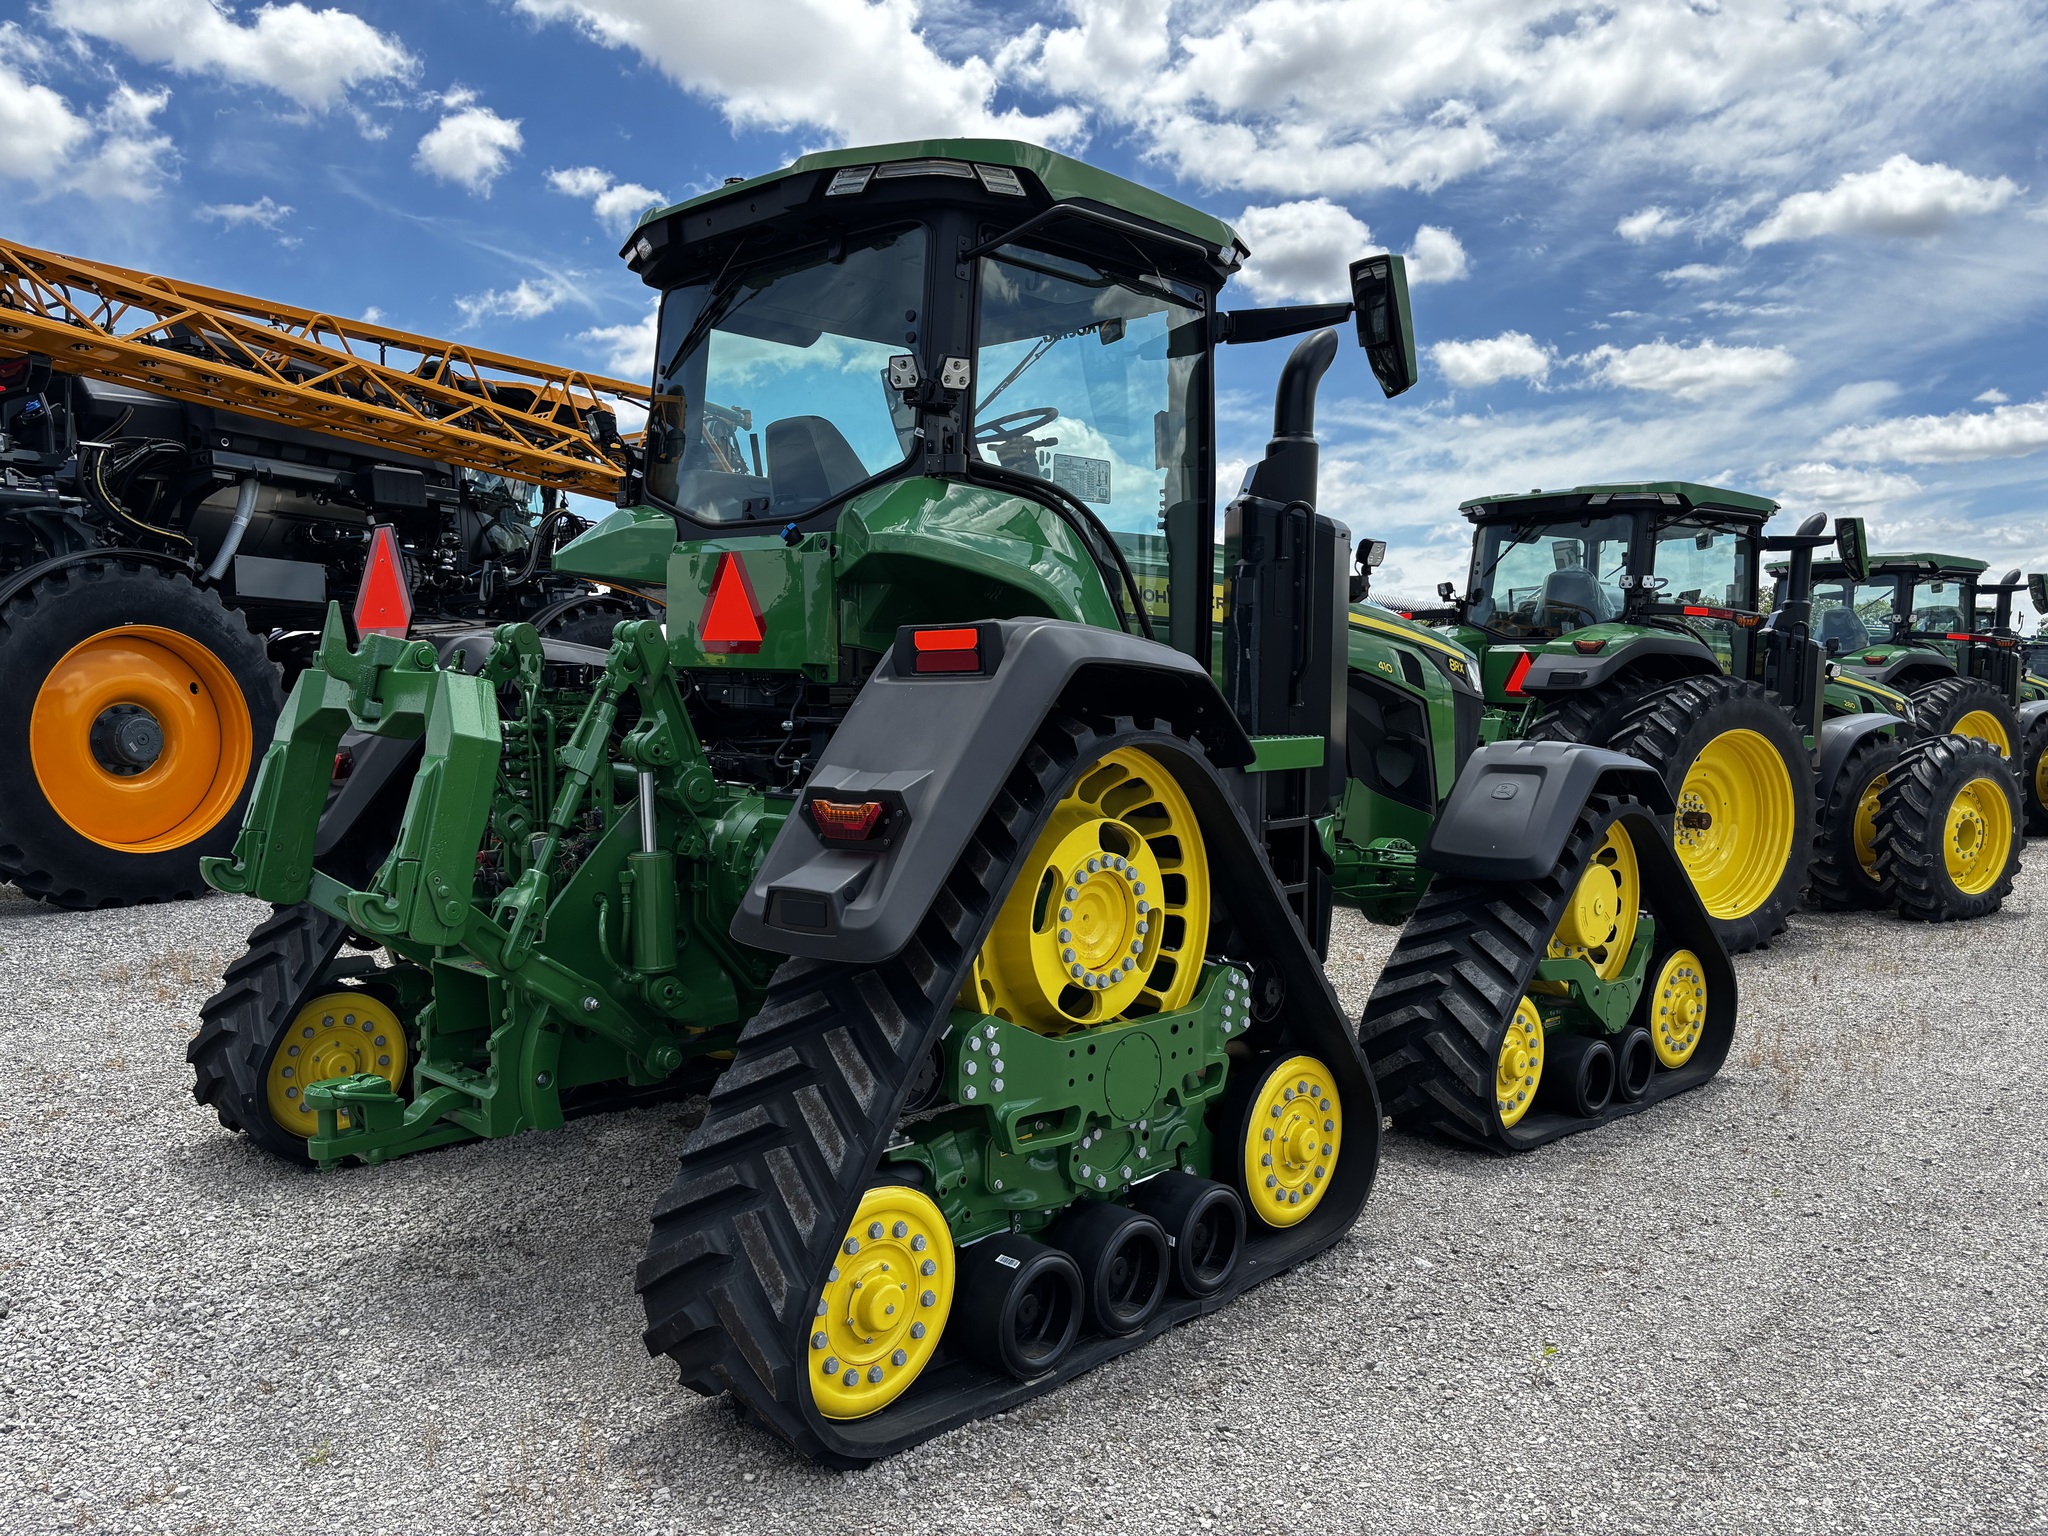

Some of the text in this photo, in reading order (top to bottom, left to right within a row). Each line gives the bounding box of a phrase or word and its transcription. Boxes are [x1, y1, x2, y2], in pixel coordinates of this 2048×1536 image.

[1138, 585, 1170, 604] JOH
[1378, 661, 1393, 673] 410
[1449, 658, 1465, 674] 8RX
